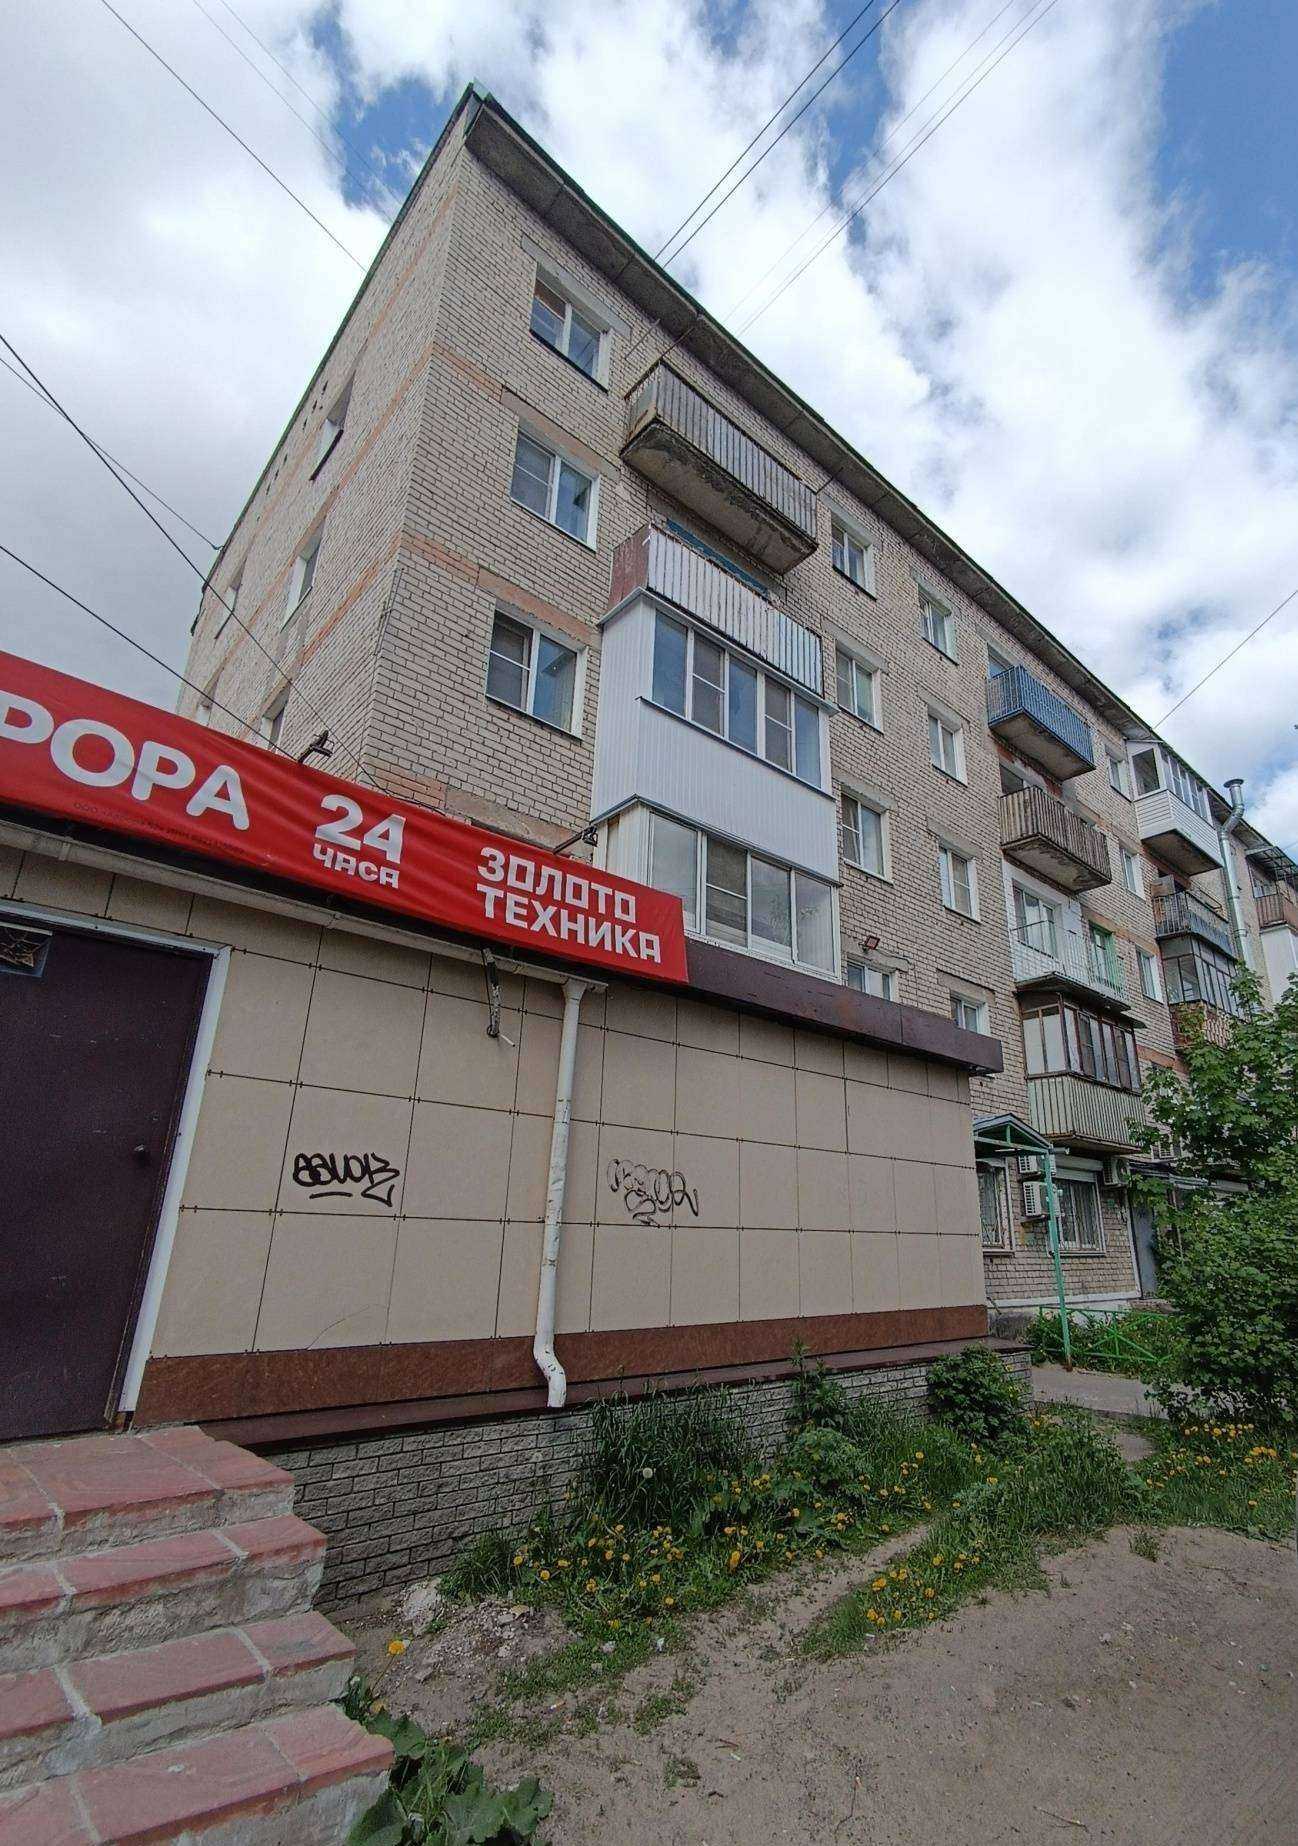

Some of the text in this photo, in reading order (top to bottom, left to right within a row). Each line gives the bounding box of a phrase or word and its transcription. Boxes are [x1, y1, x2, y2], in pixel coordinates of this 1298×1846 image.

[315, 794, 407, 864] 24
[313, 843, 400, 889] ЧАСА
[477, 847, 636, 924] ЗОЛОТО
[476, 883, 662, 964] ТЕХНИКА
